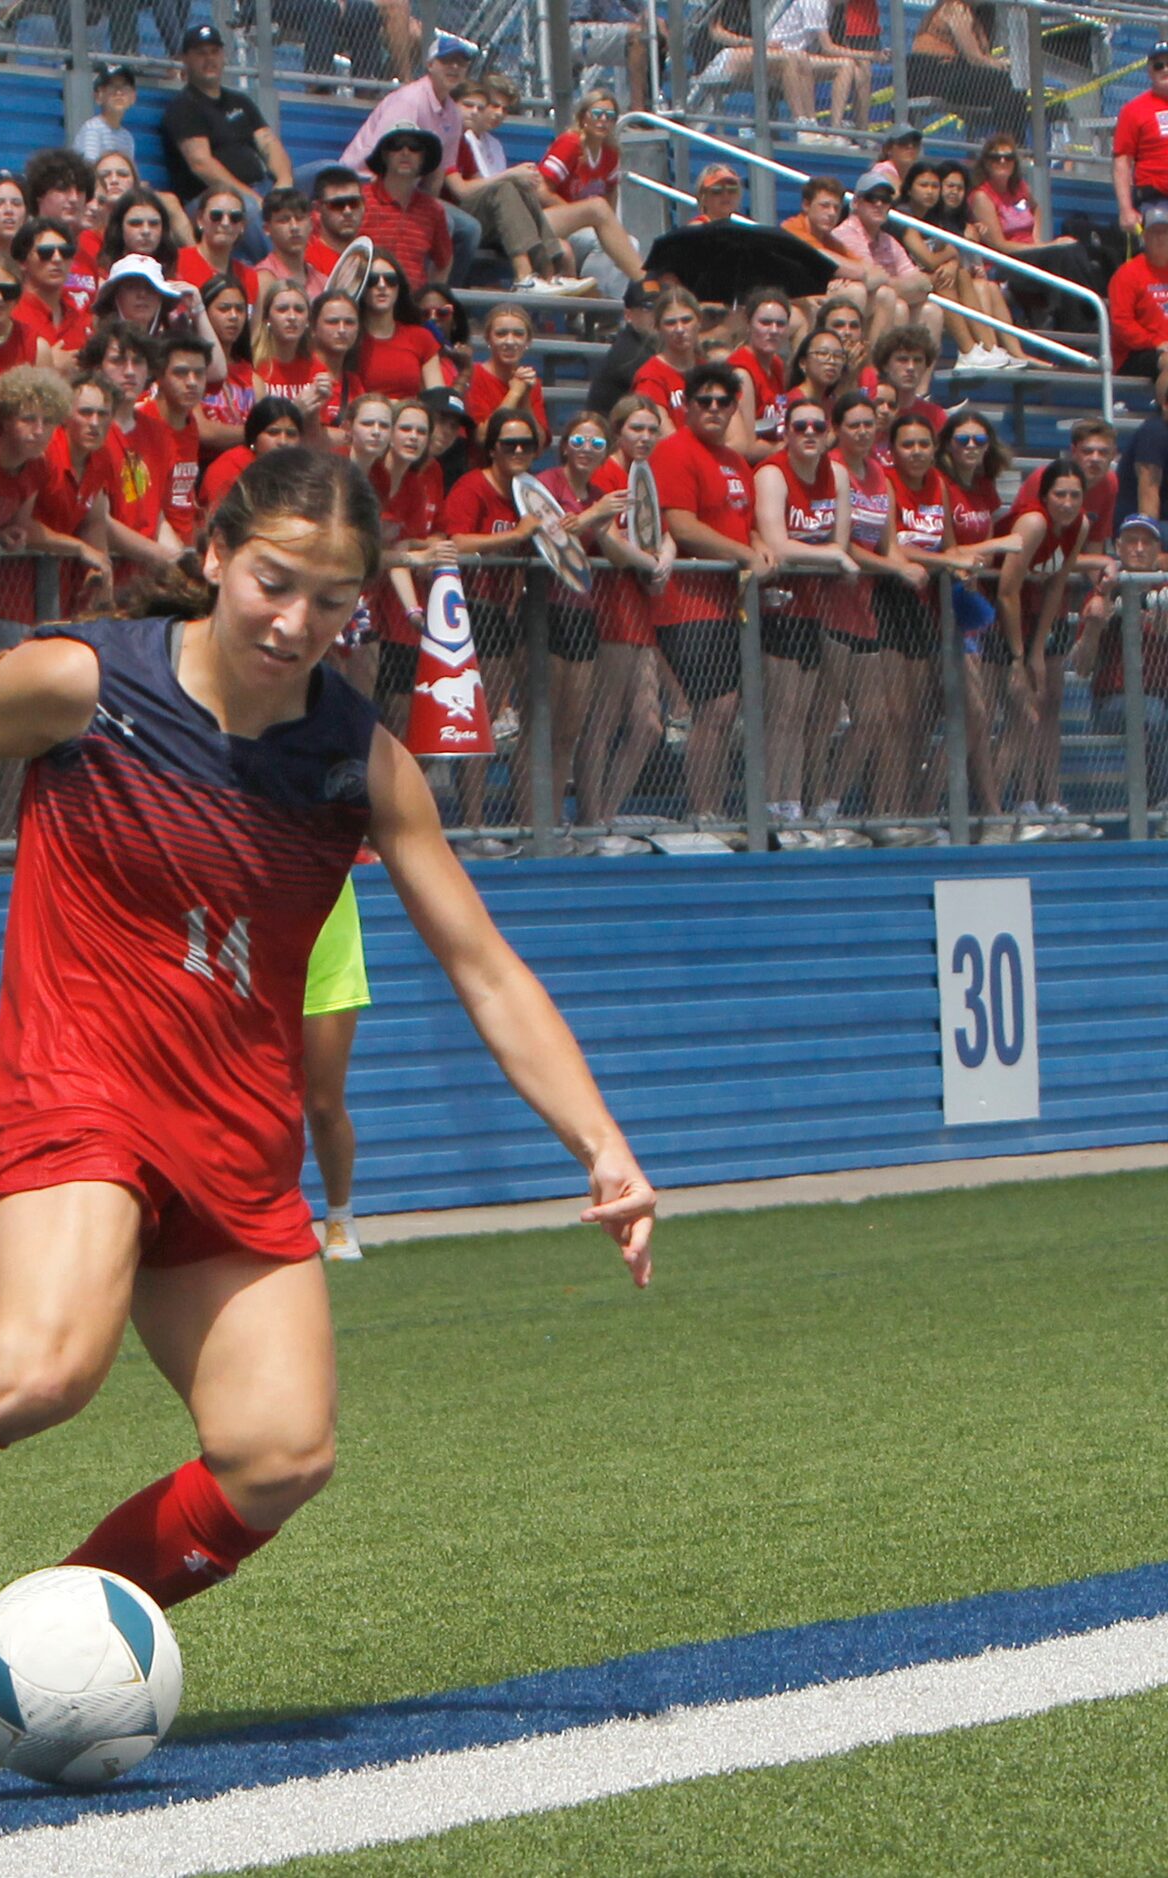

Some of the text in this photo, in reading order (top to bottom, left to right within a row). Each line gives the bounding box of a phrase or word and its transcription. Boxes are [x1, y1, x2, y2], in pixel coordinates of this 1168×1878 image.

[442, 589, 468, 630] G
[440, 726, 479, 745] Ryan
[181, 905, 252, 999] 14
[952, 932, 1025, 1070] 30
